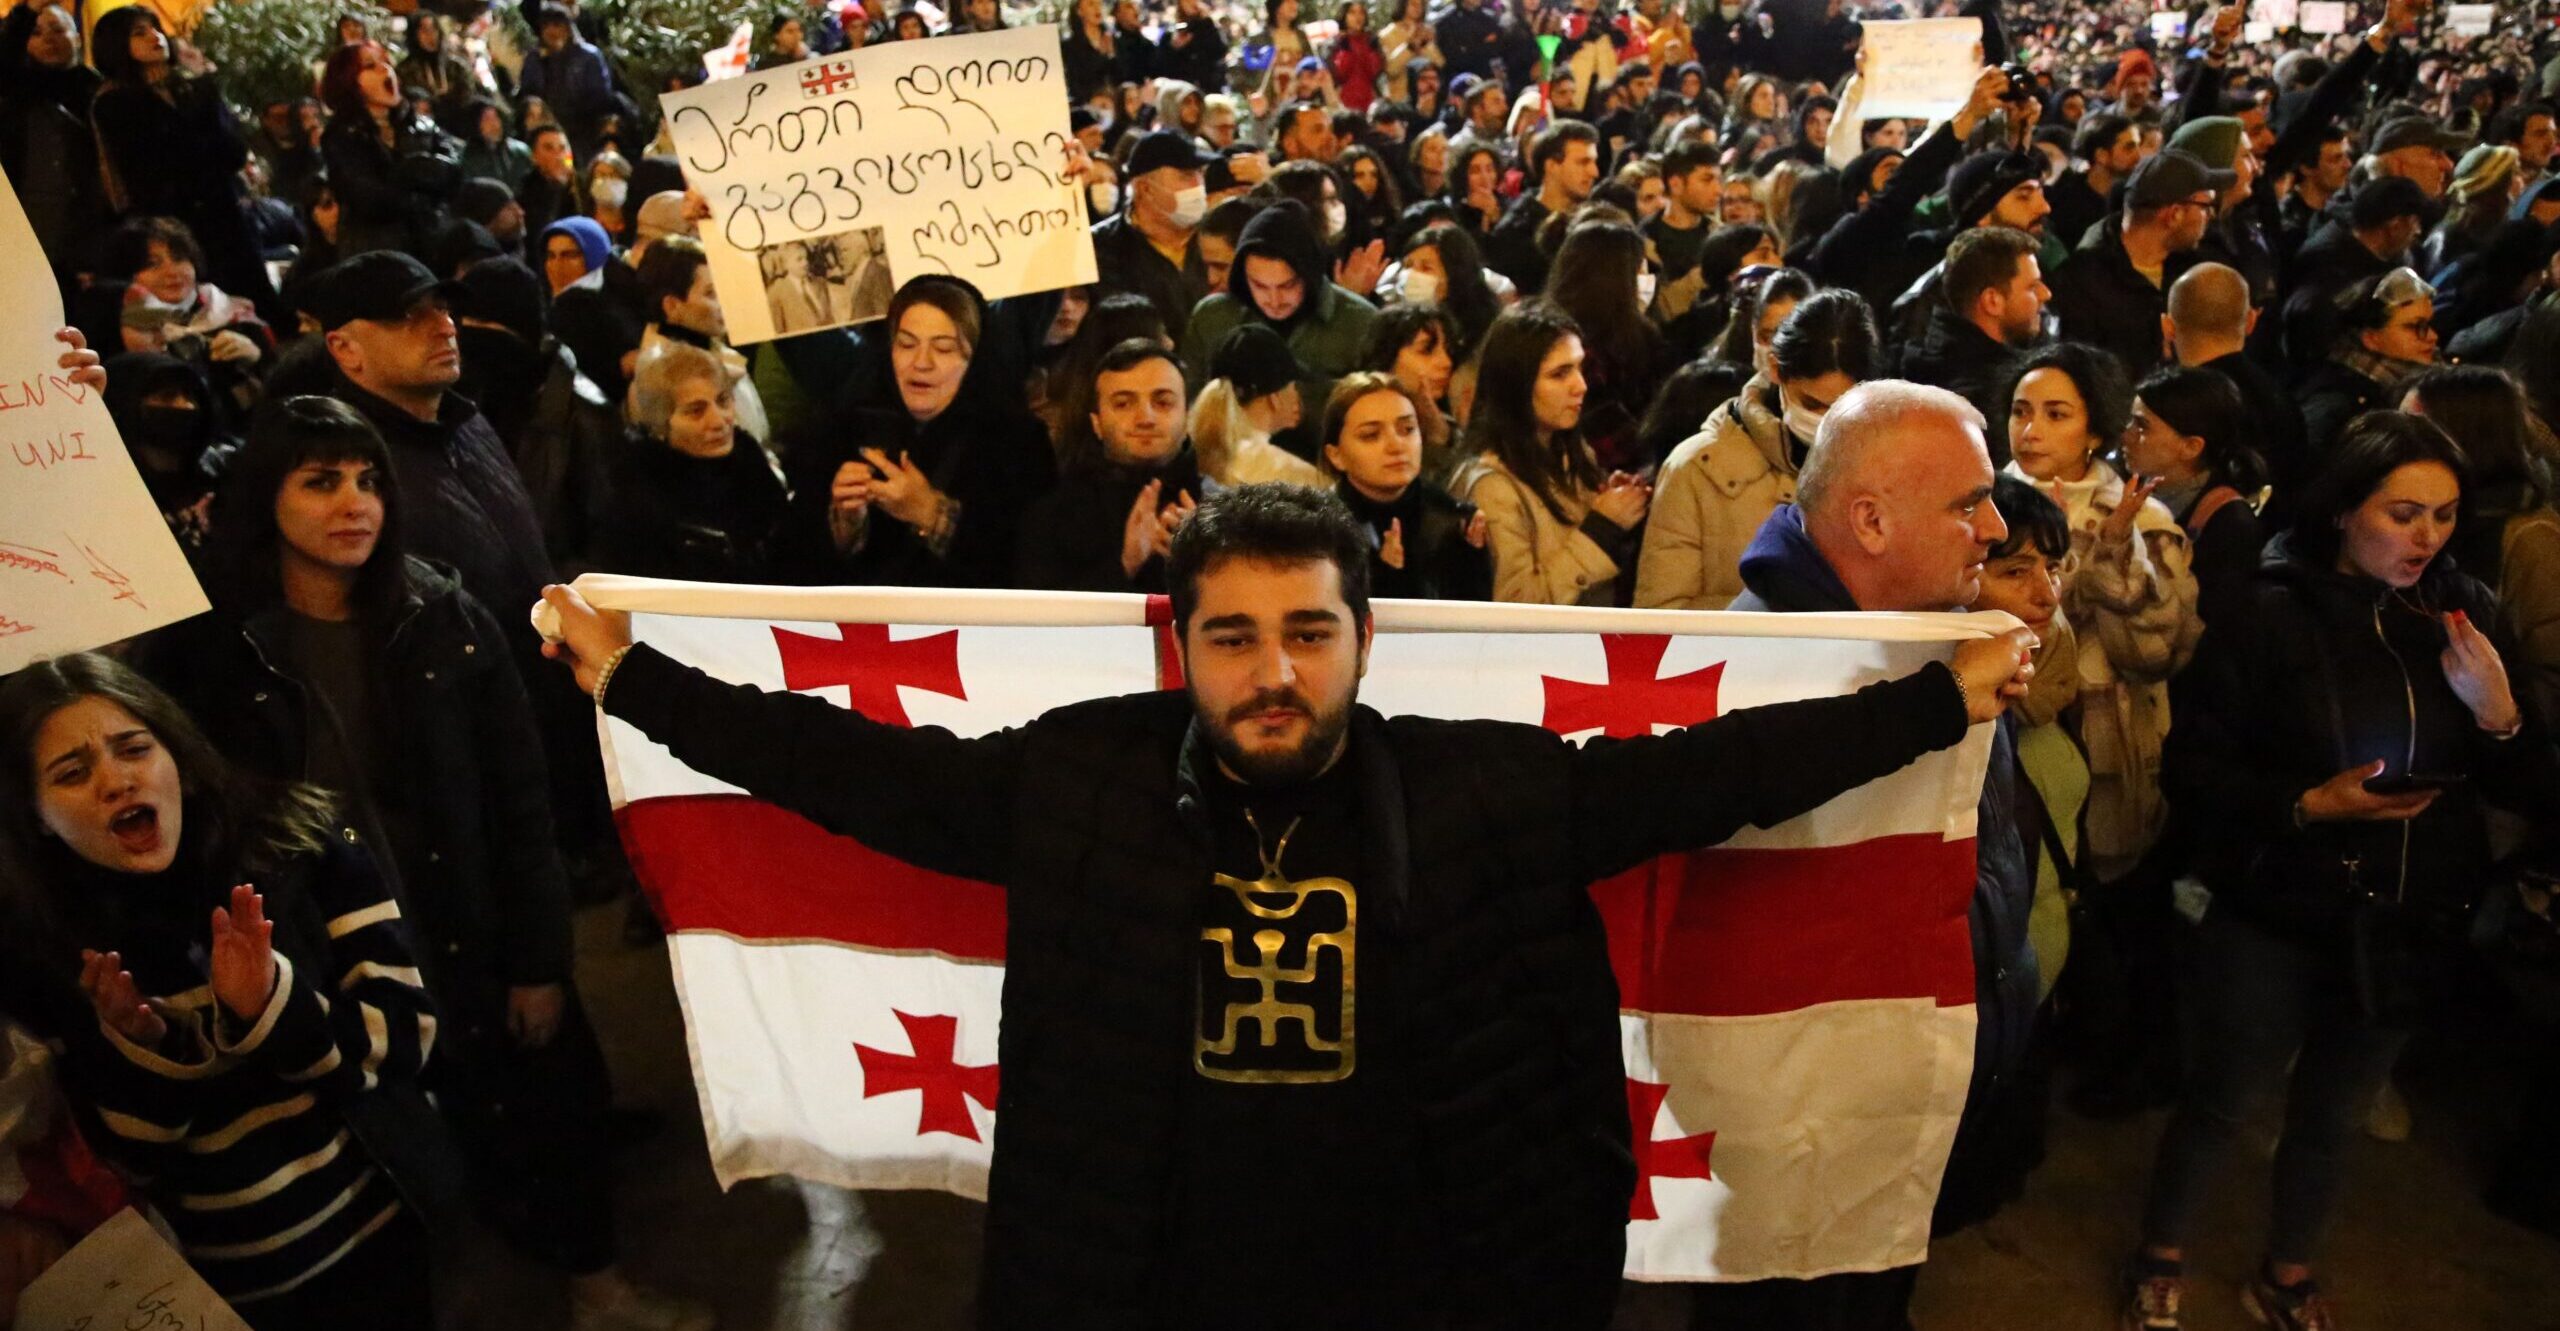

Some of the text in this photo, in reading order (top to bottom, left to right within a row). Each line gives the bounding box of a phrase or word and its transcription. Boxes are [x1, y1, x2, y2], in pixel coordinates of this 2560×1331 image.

[674, 56, 1049, 173] ერთი დღით
[912, 189, 1082, 275] ღმერთო!
[11, 431, 97, 470] UNI
